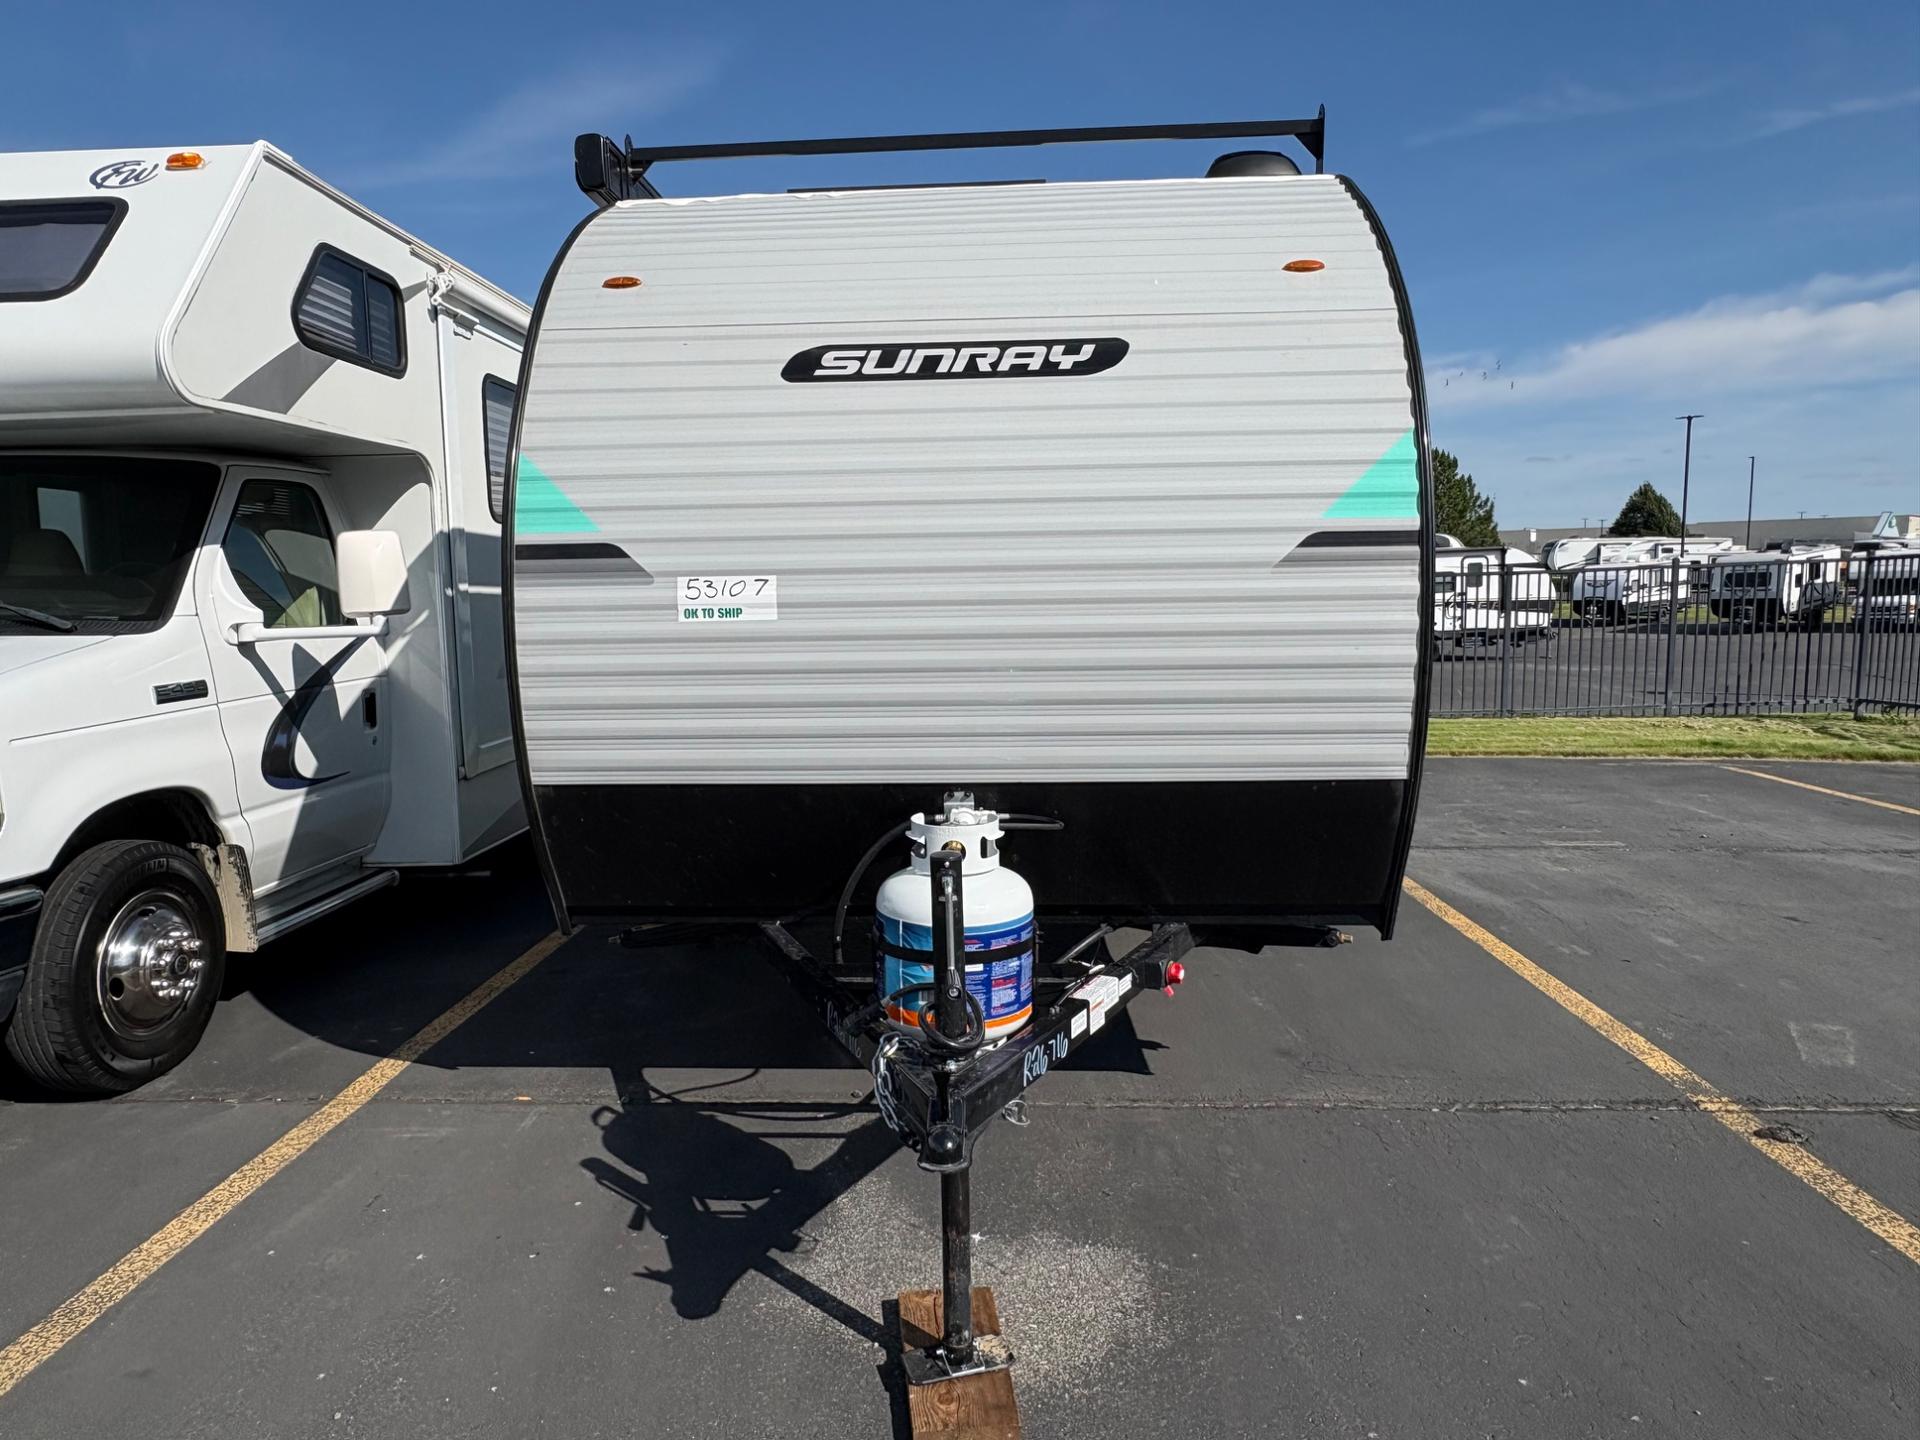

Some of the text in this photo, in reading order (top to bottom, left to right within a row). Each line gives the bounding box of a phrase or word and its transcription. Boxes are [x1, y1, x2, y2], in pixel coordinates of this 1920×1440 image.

[813, 344, 1096, 376] SUNRAY
[685, 578, 769, 600] 53107
[684, 607, 743, 619] OK TO SHIP
